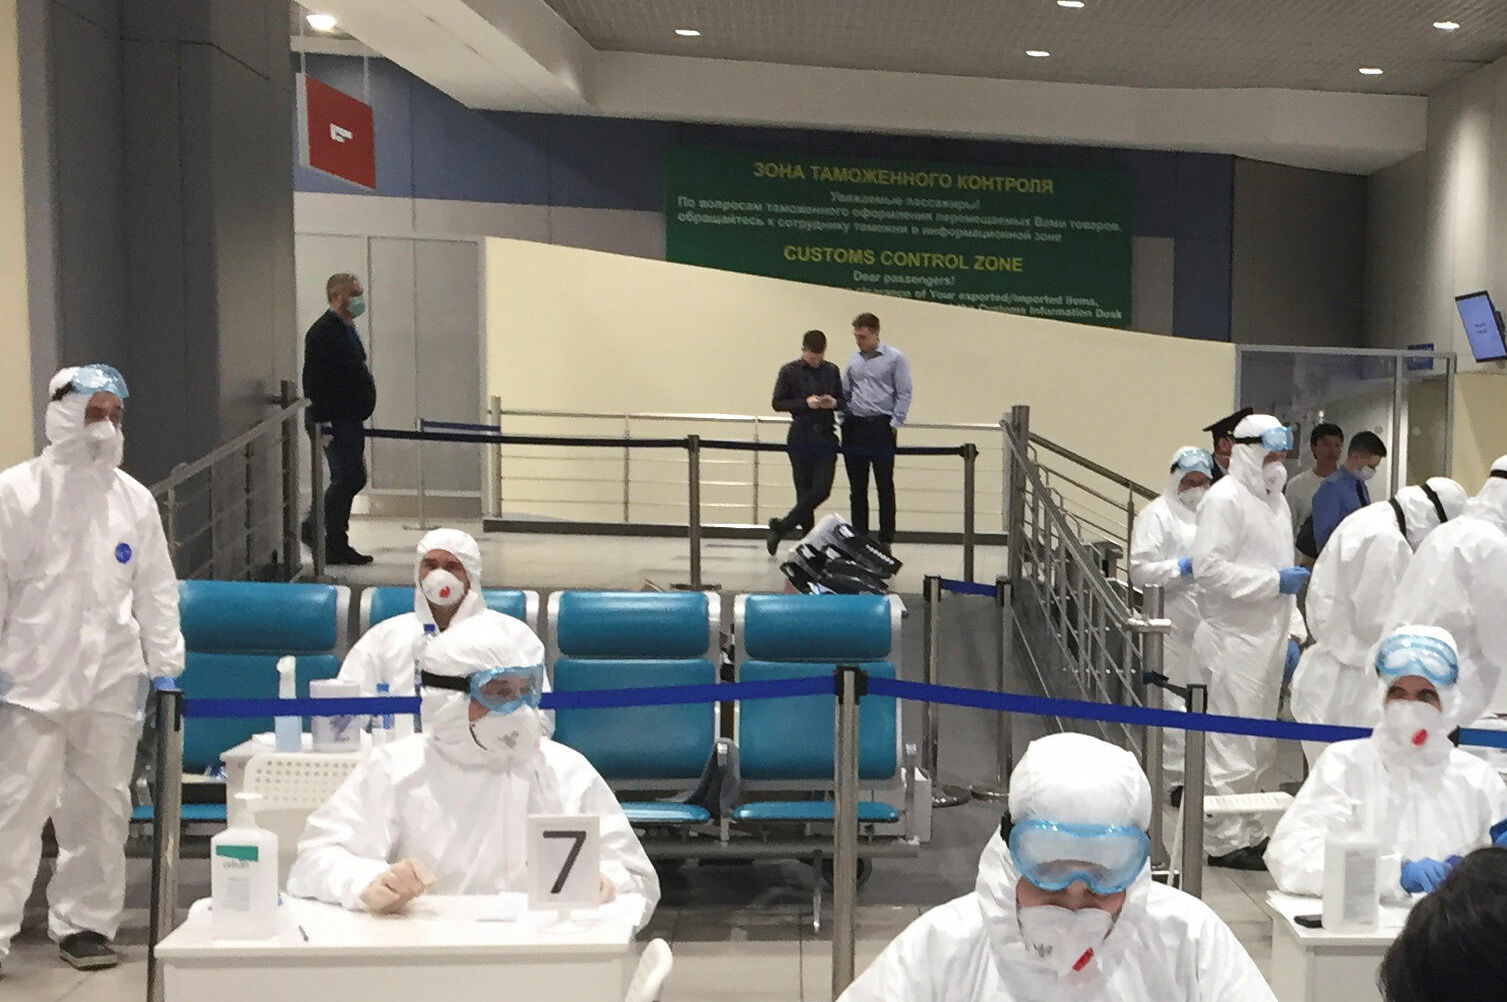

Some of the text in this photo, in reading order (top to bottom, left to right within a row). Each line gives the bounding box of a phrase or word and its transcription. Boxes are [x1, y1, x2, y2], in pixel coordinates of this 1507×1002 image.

[753, 162, 1054, 194] ЗОНА ТАМОЖЕННОГО КОНТРОЛЯ
[783, 245, 1024, 272] CUSTOMS CONTROL ZONE
[853, 270, 956, 288] Dear passengers!
[543, 830, 587, 894] 7
